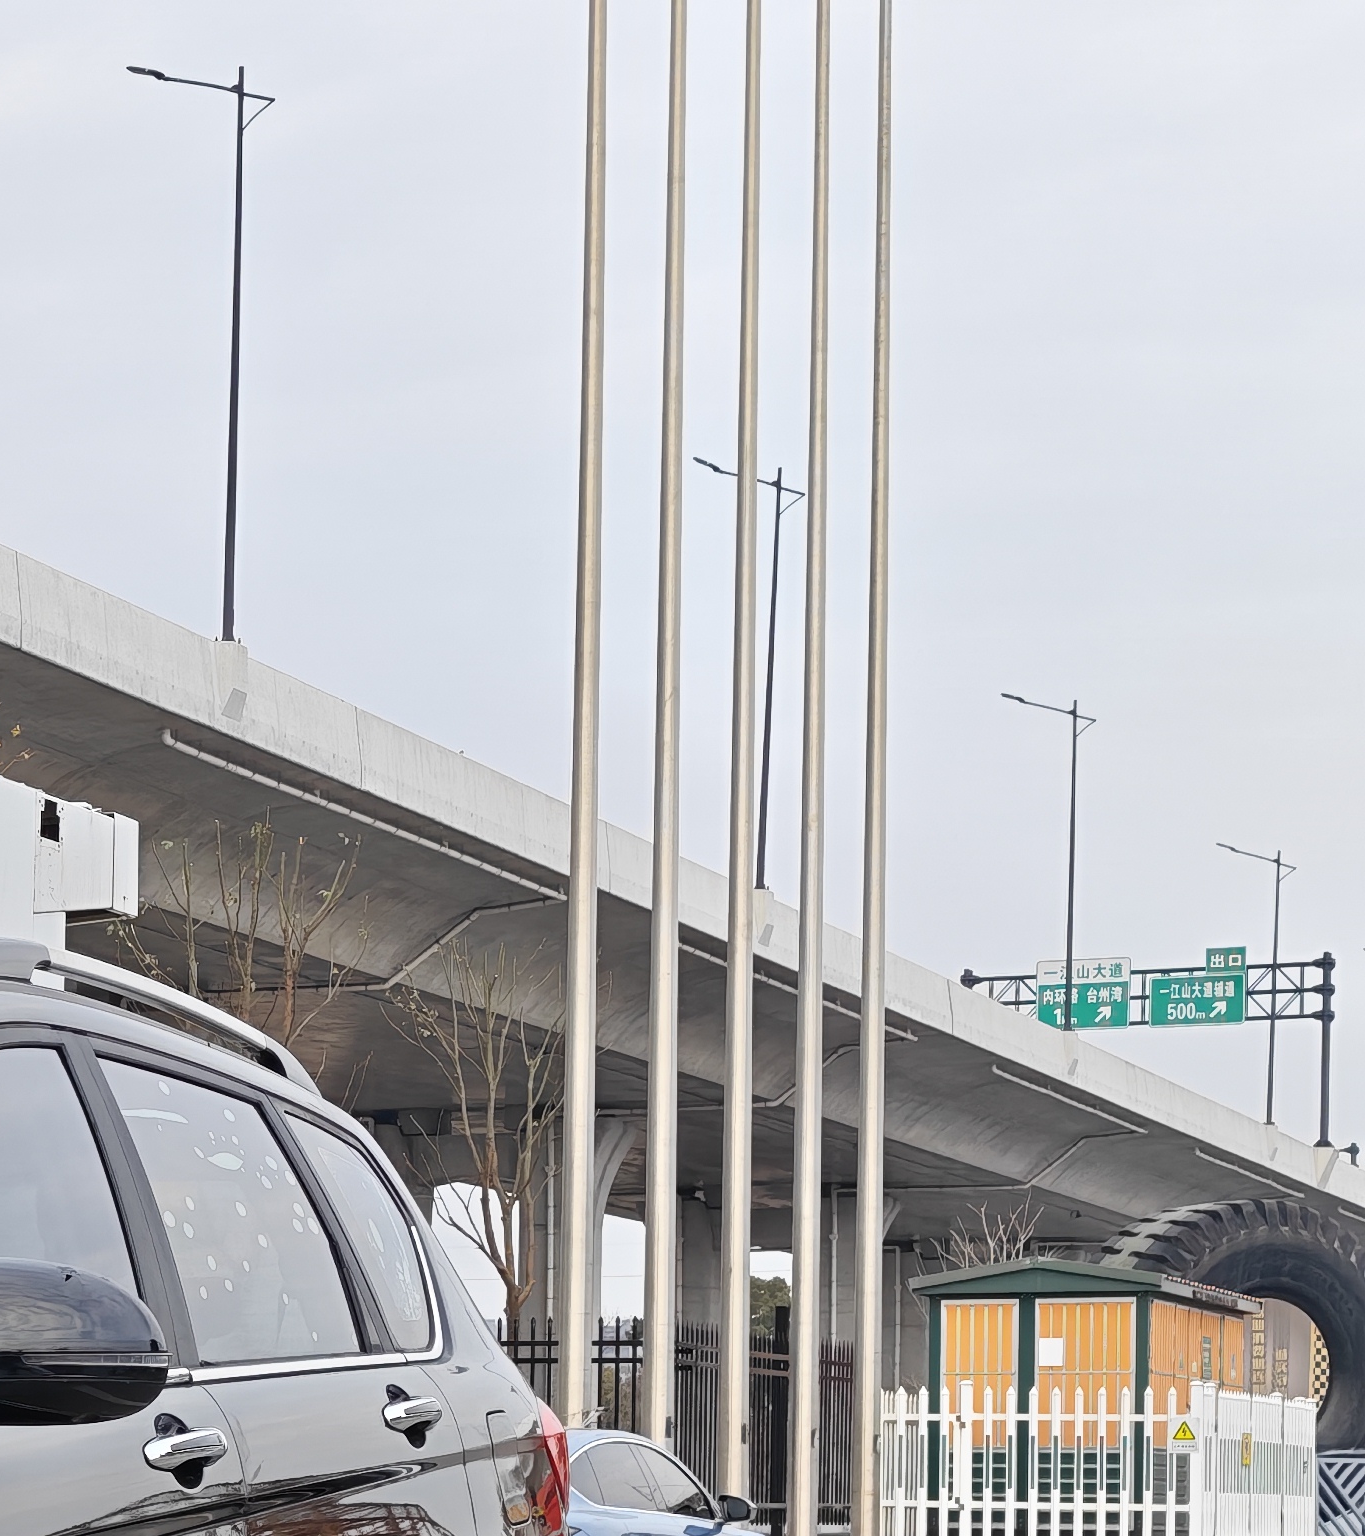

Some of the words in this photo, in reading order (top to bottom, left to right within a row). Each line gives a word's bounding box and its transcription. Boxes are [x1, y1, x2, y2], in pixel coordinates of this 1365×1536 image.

[1210, 954, 1242, 967] 出口
[1087, 985, 1123, 1004] 台州湾
